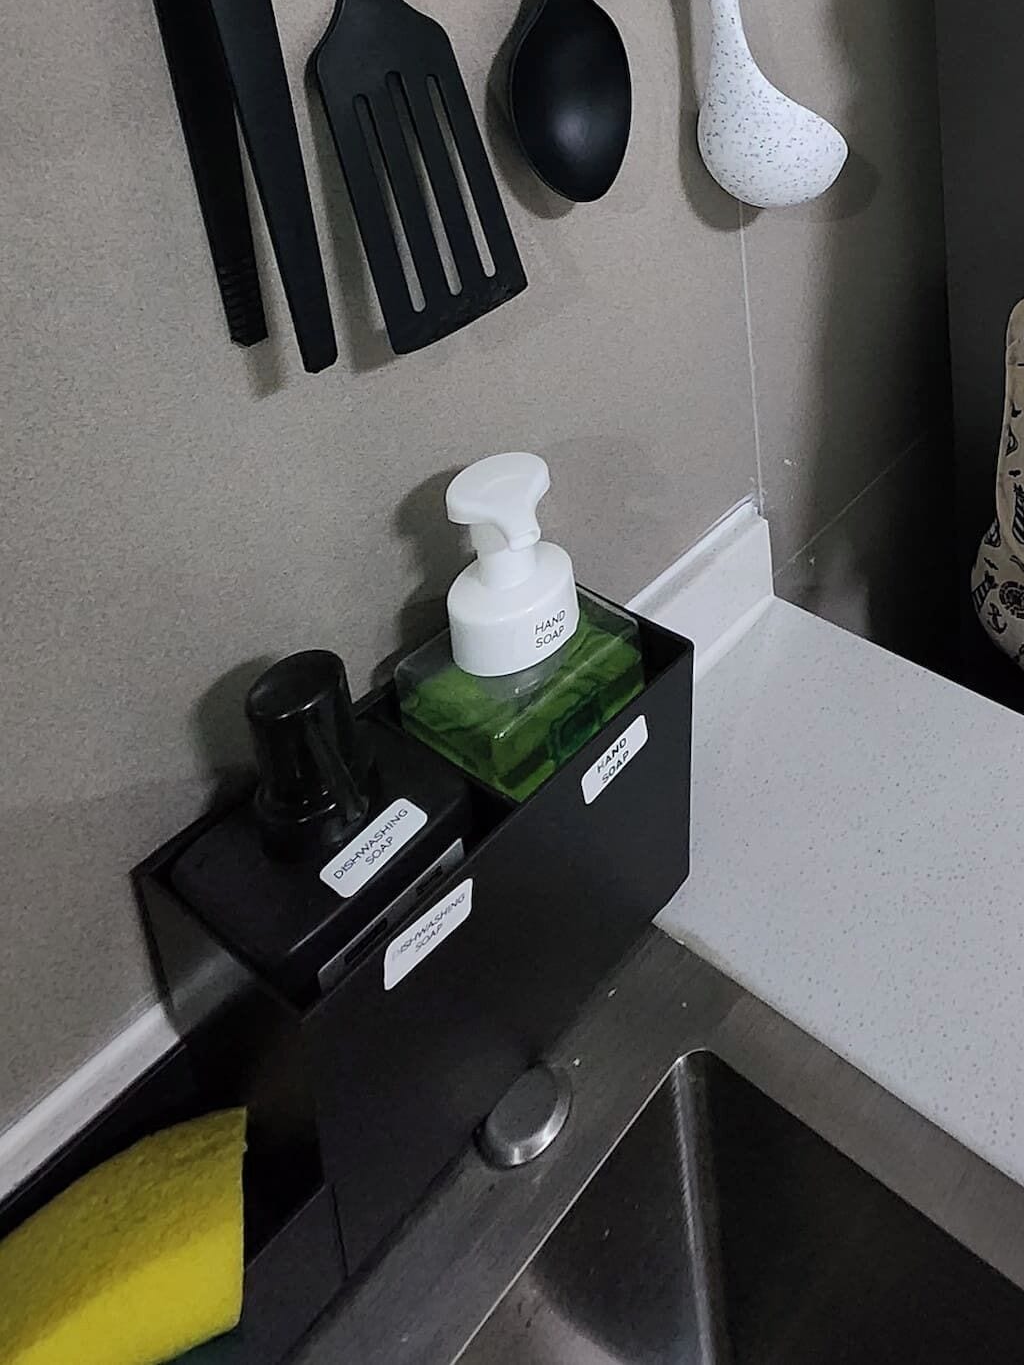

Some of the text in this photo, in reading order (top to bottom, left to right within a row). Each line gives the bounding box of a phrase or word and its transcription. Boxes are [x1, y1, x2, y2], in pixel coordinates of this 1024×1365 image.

[535, 610, 565, 635] HAND
[535, 625, 565, 649] SOAP
[597, 738, 627, 773] HAND
[602, 751, 629, 784] SOAP
[334, 809, 408, 879] DISHWASHING
[365, 836, 394, 865] SOAP
[415, 923, 443, 952] SOAP
